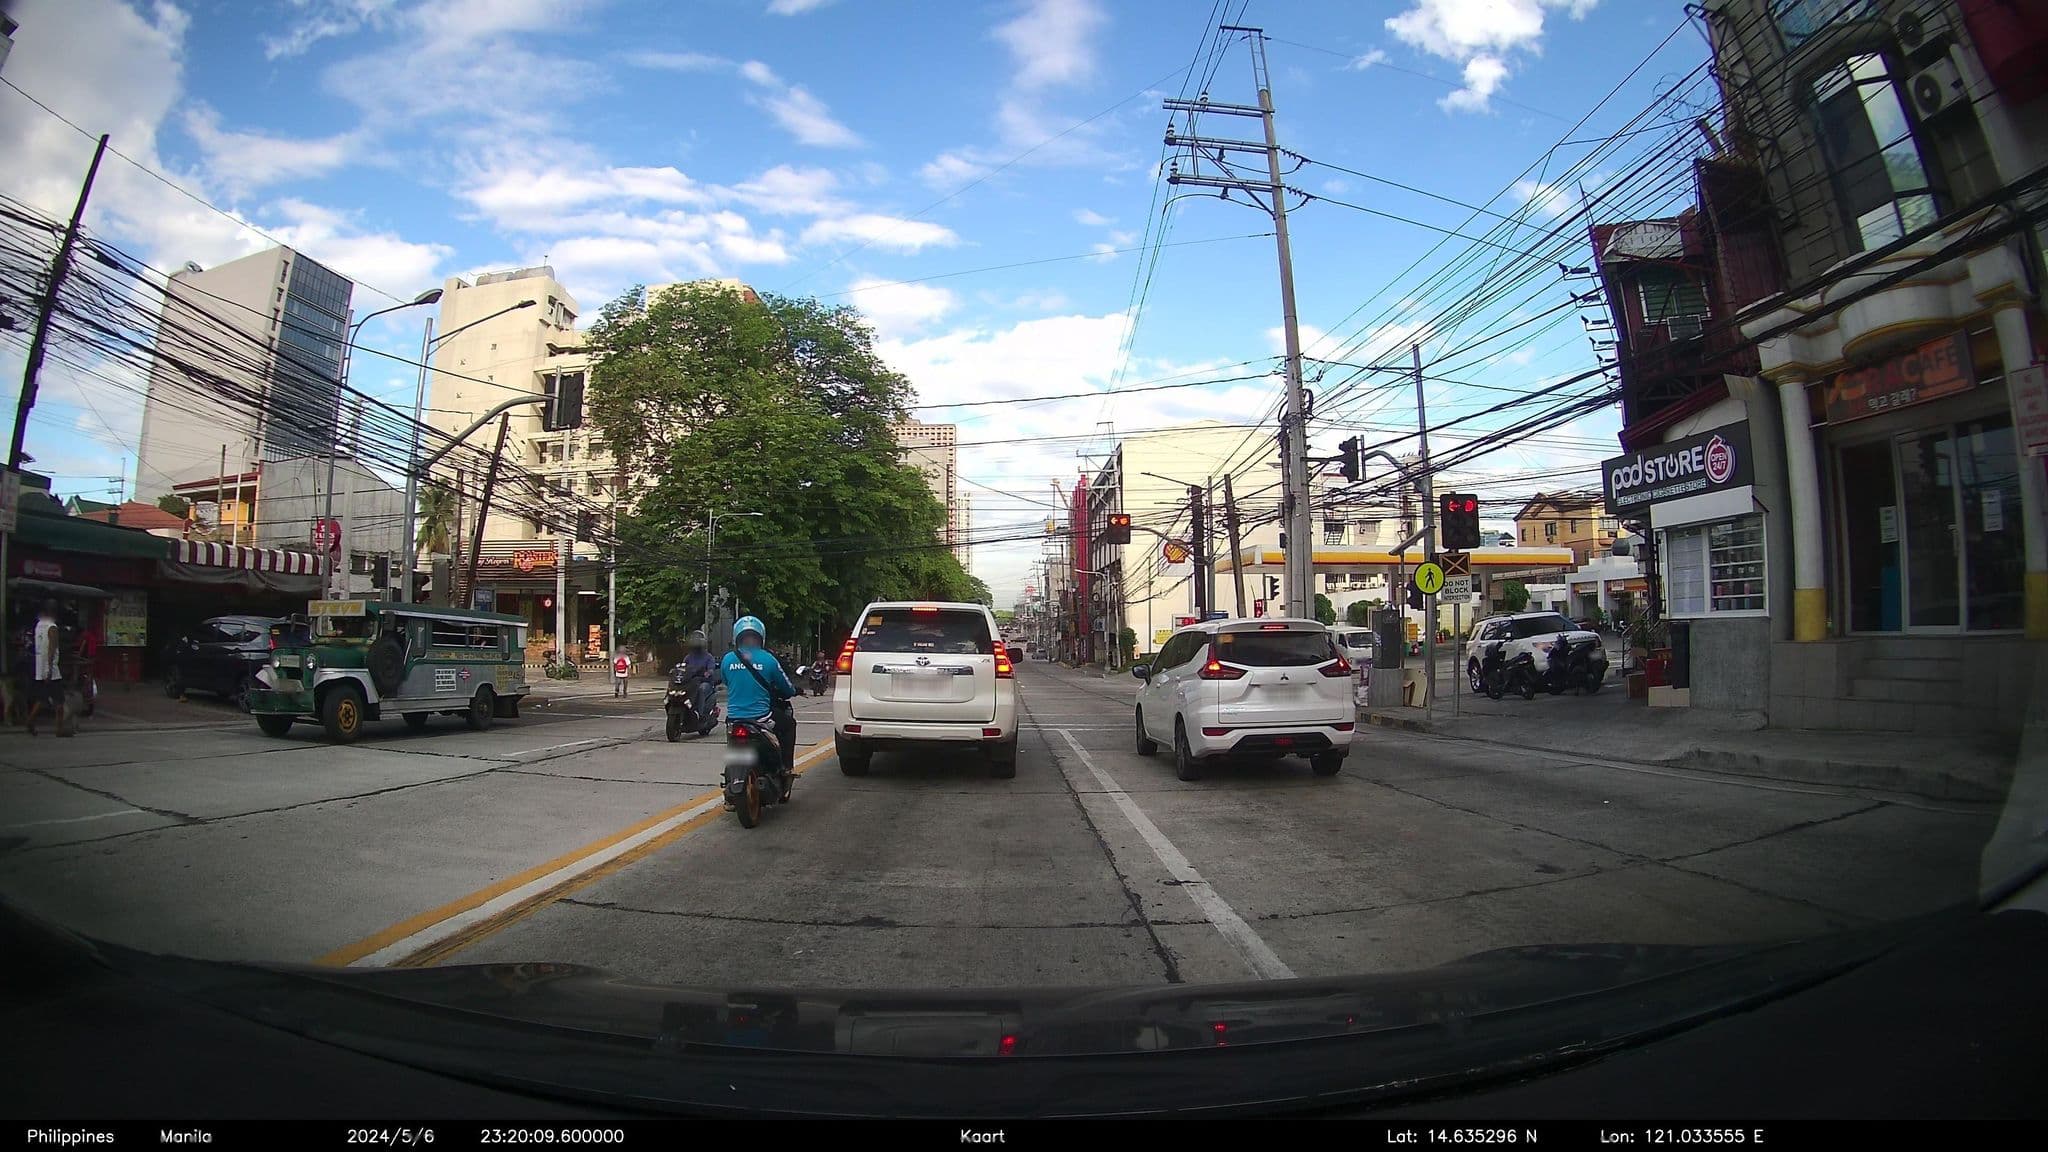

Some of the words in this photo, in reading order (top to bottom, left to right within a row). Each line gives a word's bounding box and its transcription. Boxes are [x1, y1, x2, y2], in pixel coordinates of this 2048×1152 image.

[1711, 453, 1728, 462] OPEN
[1712, 461, 1727, 471] 24/7
[1612, 454, 1643, 499] pod
[1644, 446, 1705, 484] STORE
